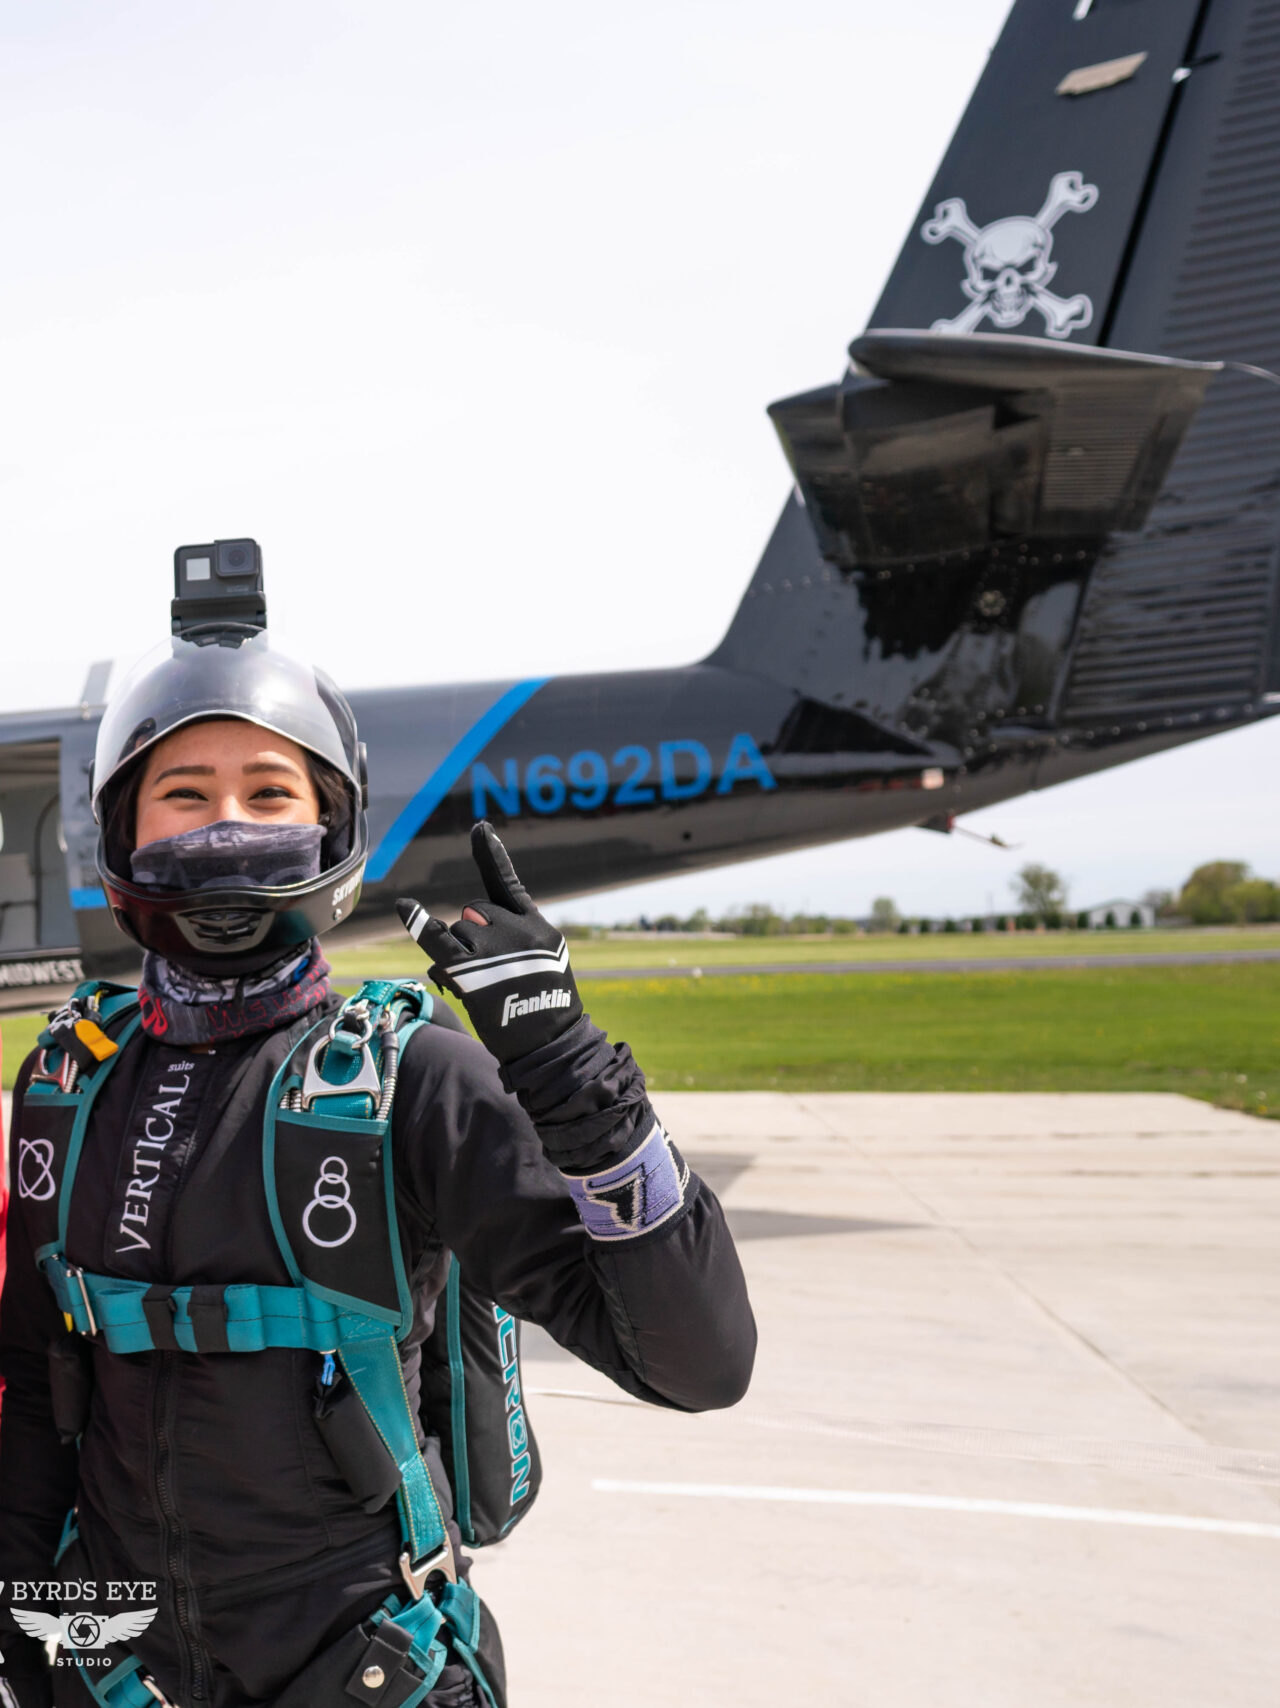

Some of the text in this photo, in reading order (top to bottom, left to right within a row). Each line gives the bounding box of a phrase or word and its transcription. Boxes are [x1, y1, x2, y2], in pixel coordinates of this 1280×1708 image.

[471, 732, 778, 819] N692DA
[167, 1060, 195, 1072] suits
[115, 1074, 190, 1253] VERTICAL
